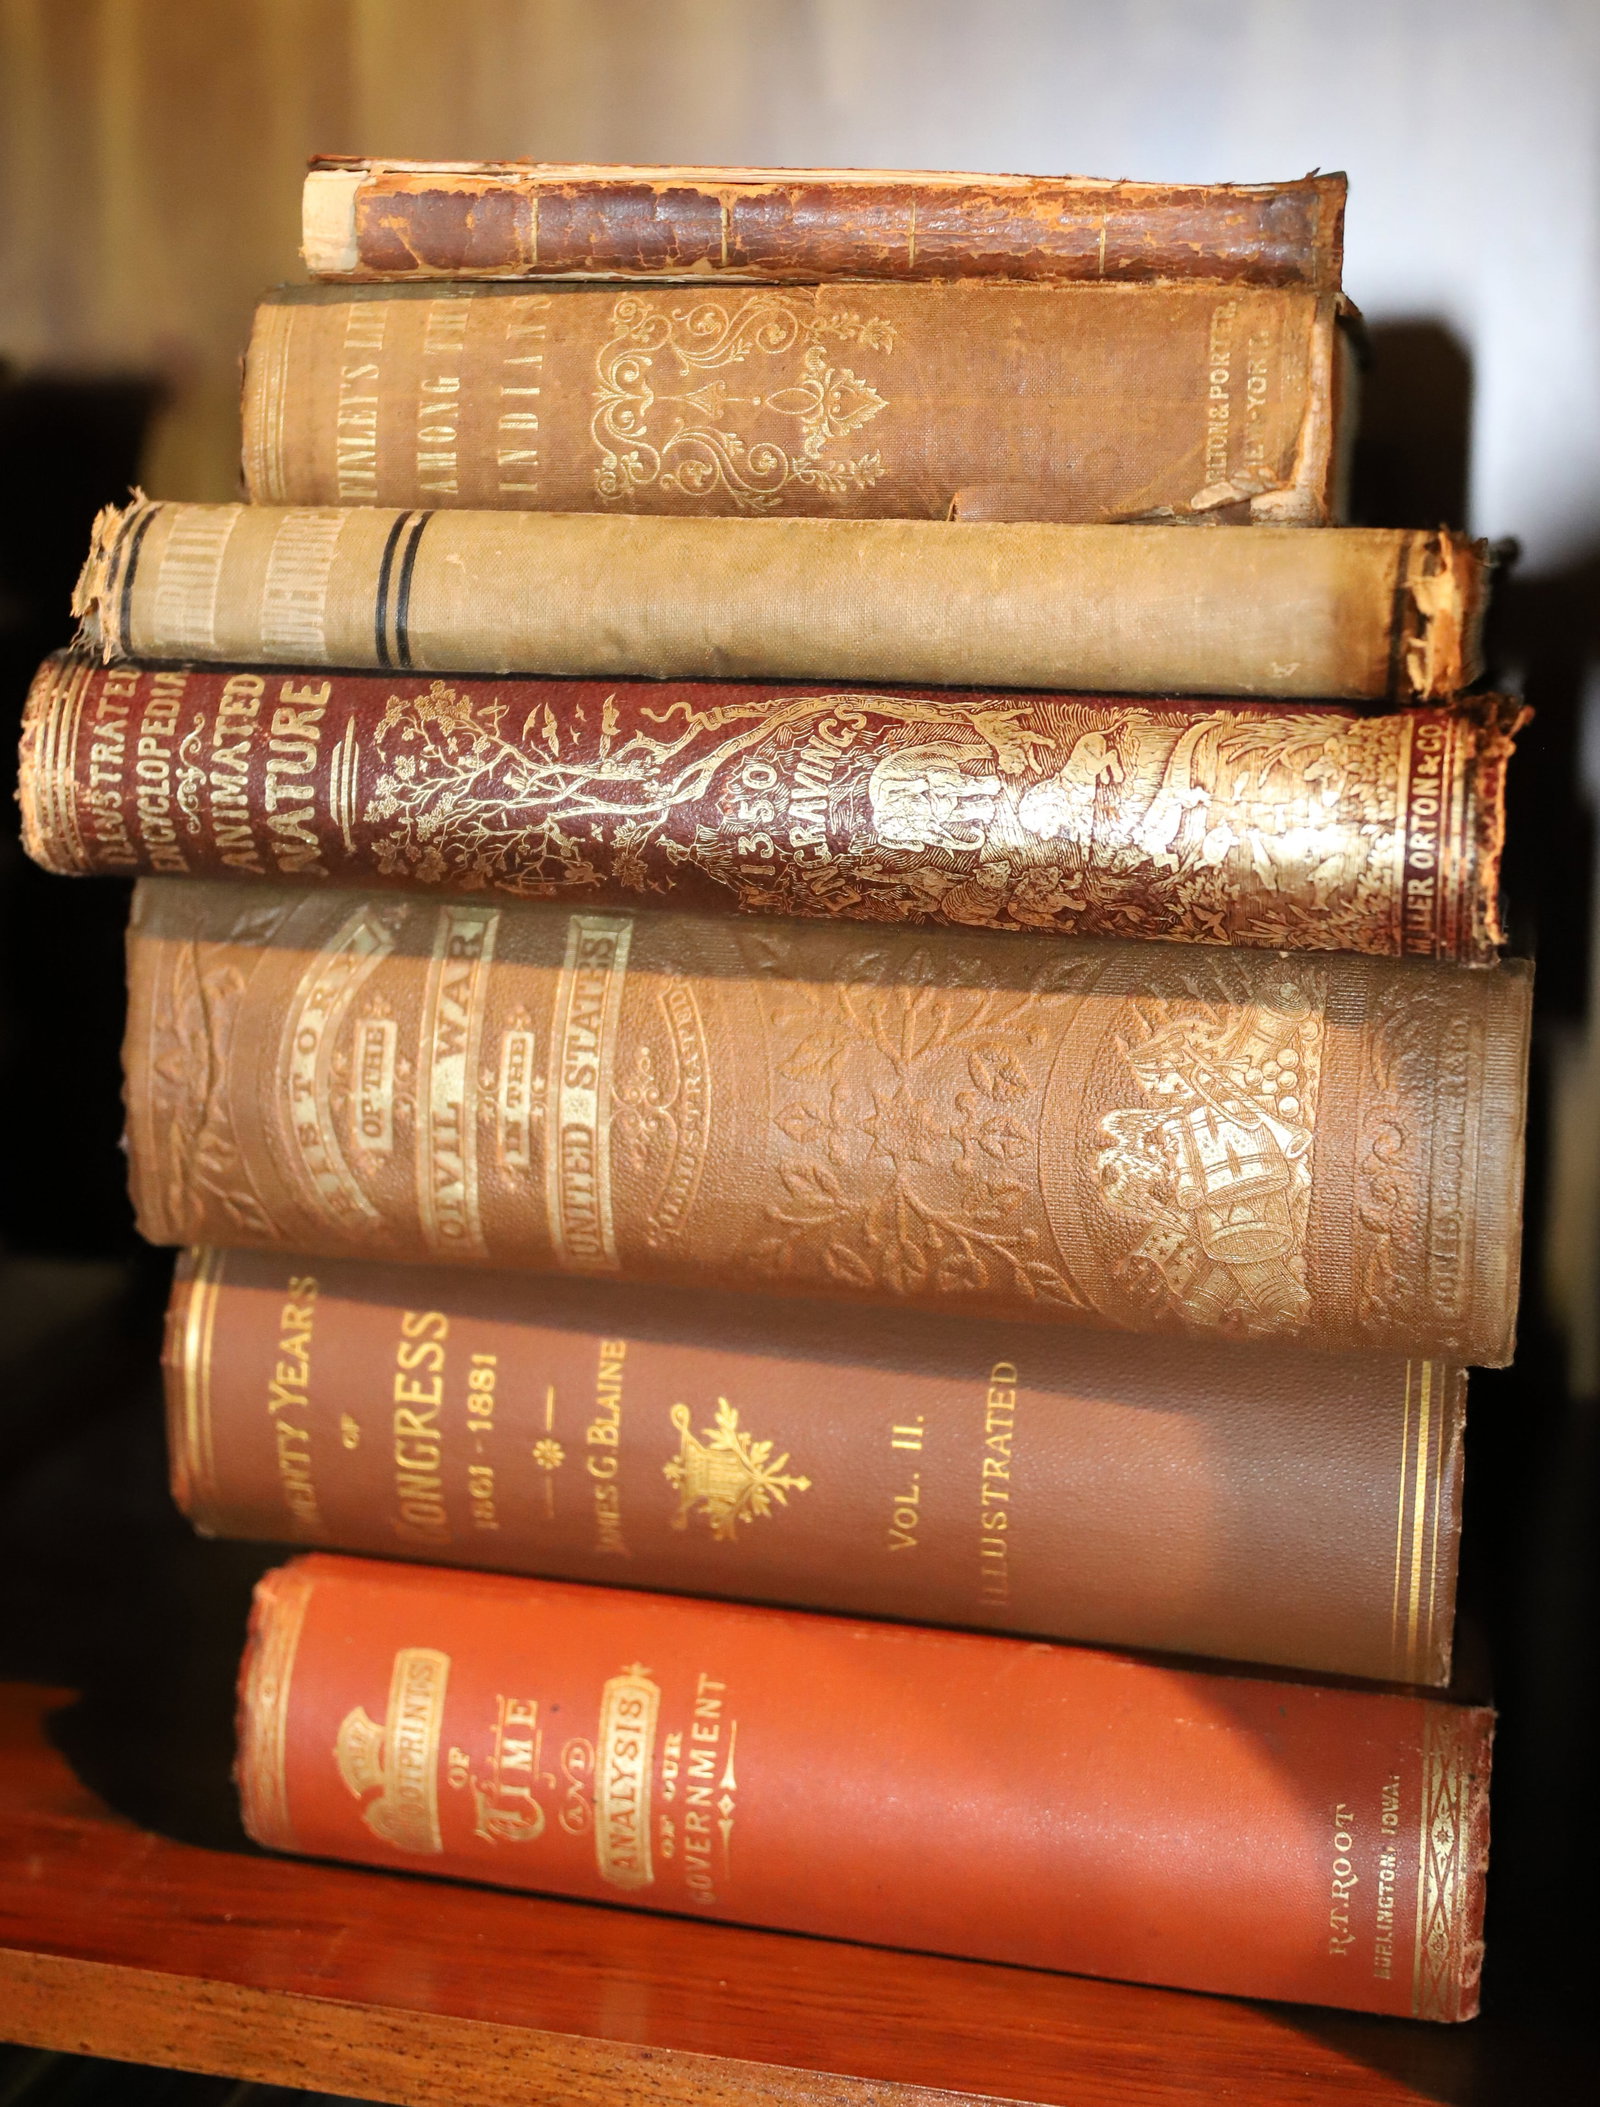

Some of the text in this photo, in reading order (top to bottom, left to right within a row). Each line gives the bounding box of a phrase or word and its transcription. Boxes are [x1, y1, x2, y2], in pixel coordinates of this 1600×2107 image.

[336, 362, 379, 497] FINLEY'S
[415, 375, 460, 493] AMONG
[497, 293, 552, 492] INDIANS
[135, 670, 191, 872] ENCYCLOPEDIA
[209, 672, 266, 874] ANIMATED
[264, 679, 332, 876] NATURE
[737, 761, 778, 876] 1350
[788, 704, 868, 910] ENGRAVINGS
[361, 1025, 383, 1092] THE
[432, 930, 482, 1240] CIVIL WAR
[503, 1036, 526, 1155] IN THE
[562, 937, 615, 1253] UNITED STATES
[267, 1275, 319, 1414] YEARS
[466, 1352, 497, 1432] 1881
[586, 1339, 626, 1446] BLAINE
[340, 1411, 360, 1448] OF
[889, 1471, 920, 1550] VOL.
[448, 1745, 470, 1788] OF
[470, 1693, 546, 1841] TIME
[564, 1740, 588, 1831] AND
[608, 1694, 644, 1870] ANALYSIS
[684, 1671, 728, 1905] GOVERNMENT
[659, 1813, 675, 1858] OF
